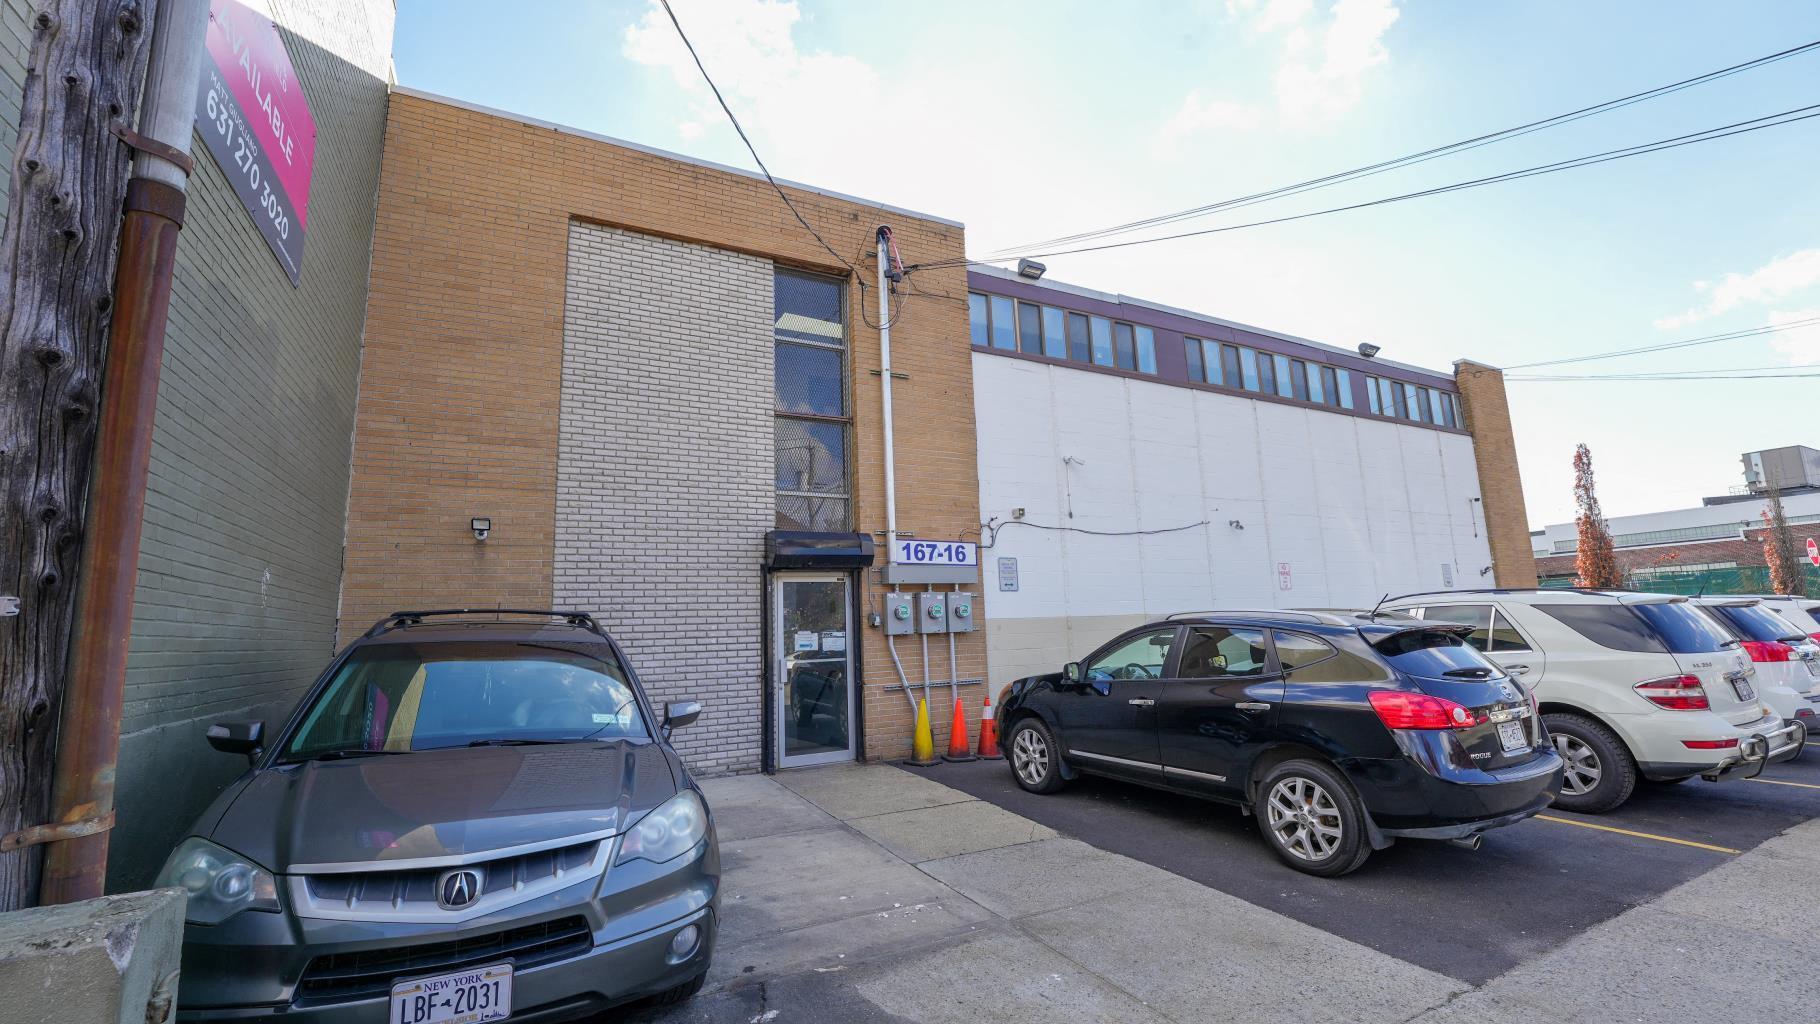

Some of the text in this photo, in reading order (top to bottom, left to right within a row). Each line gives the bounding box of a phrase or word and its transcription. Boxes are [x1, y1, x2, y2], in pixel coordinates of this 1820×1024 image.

[210, 71, 228, 105] MATT
[219, 5, 293, 167] AVAILABLE
[206, 89, 234, 147] 631
[234, 136, 260, 191] 270
[260, 180, 289, 240] 3020
[902, 543, 966, 562] 167-16
[1470, 752, 1492, 760] ROGUE
[424, 973, 483, 993] NEW YORK
